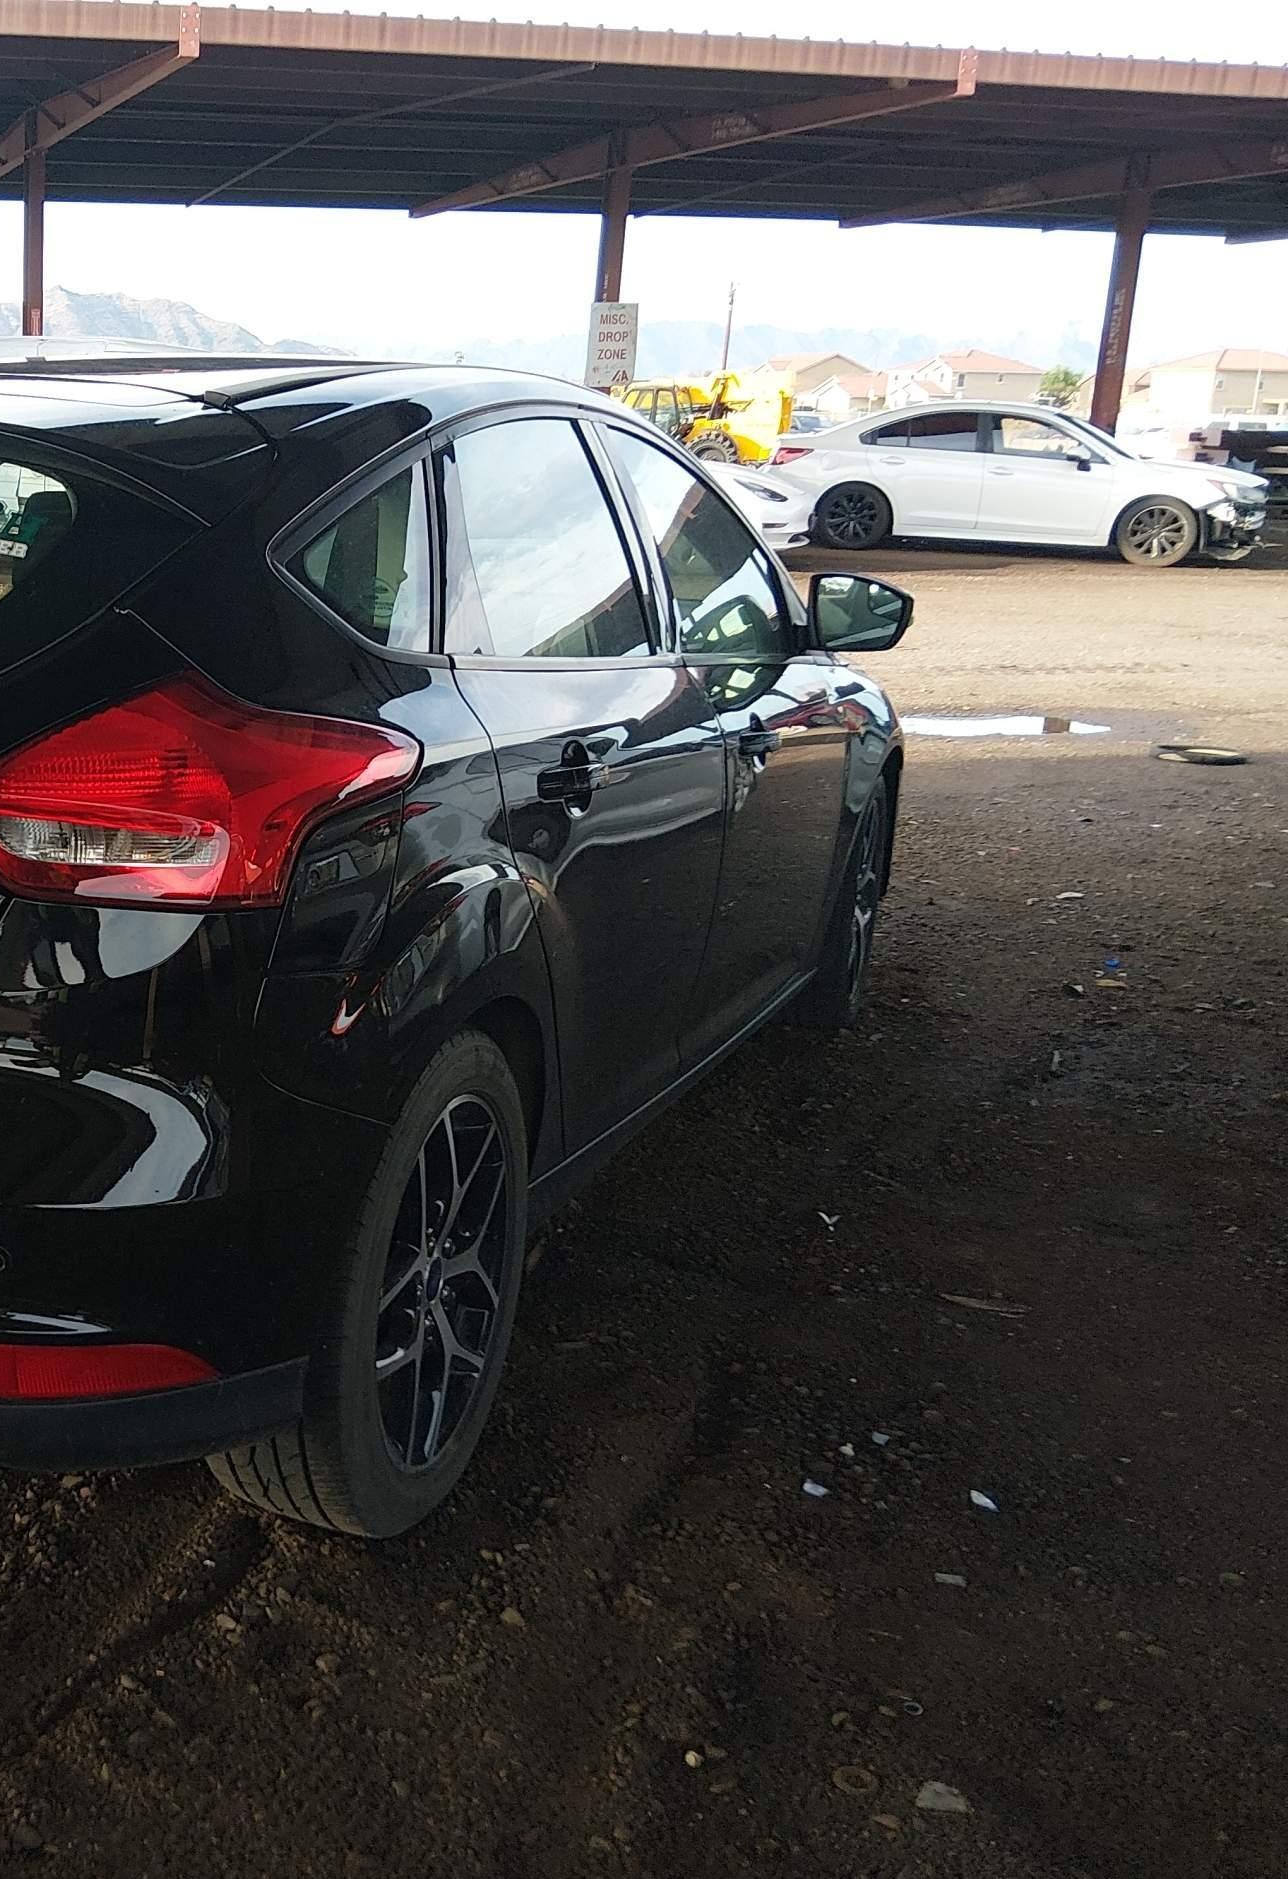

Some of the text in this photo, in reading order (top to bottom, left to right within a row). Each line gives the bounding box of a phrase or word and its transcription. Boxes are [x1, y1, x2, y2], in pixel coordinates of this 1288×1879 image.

[600, 313, 629, 325] MISC.
[598, 331, 629, 342] DROP
[597, 348, 627, 360] ZONE
